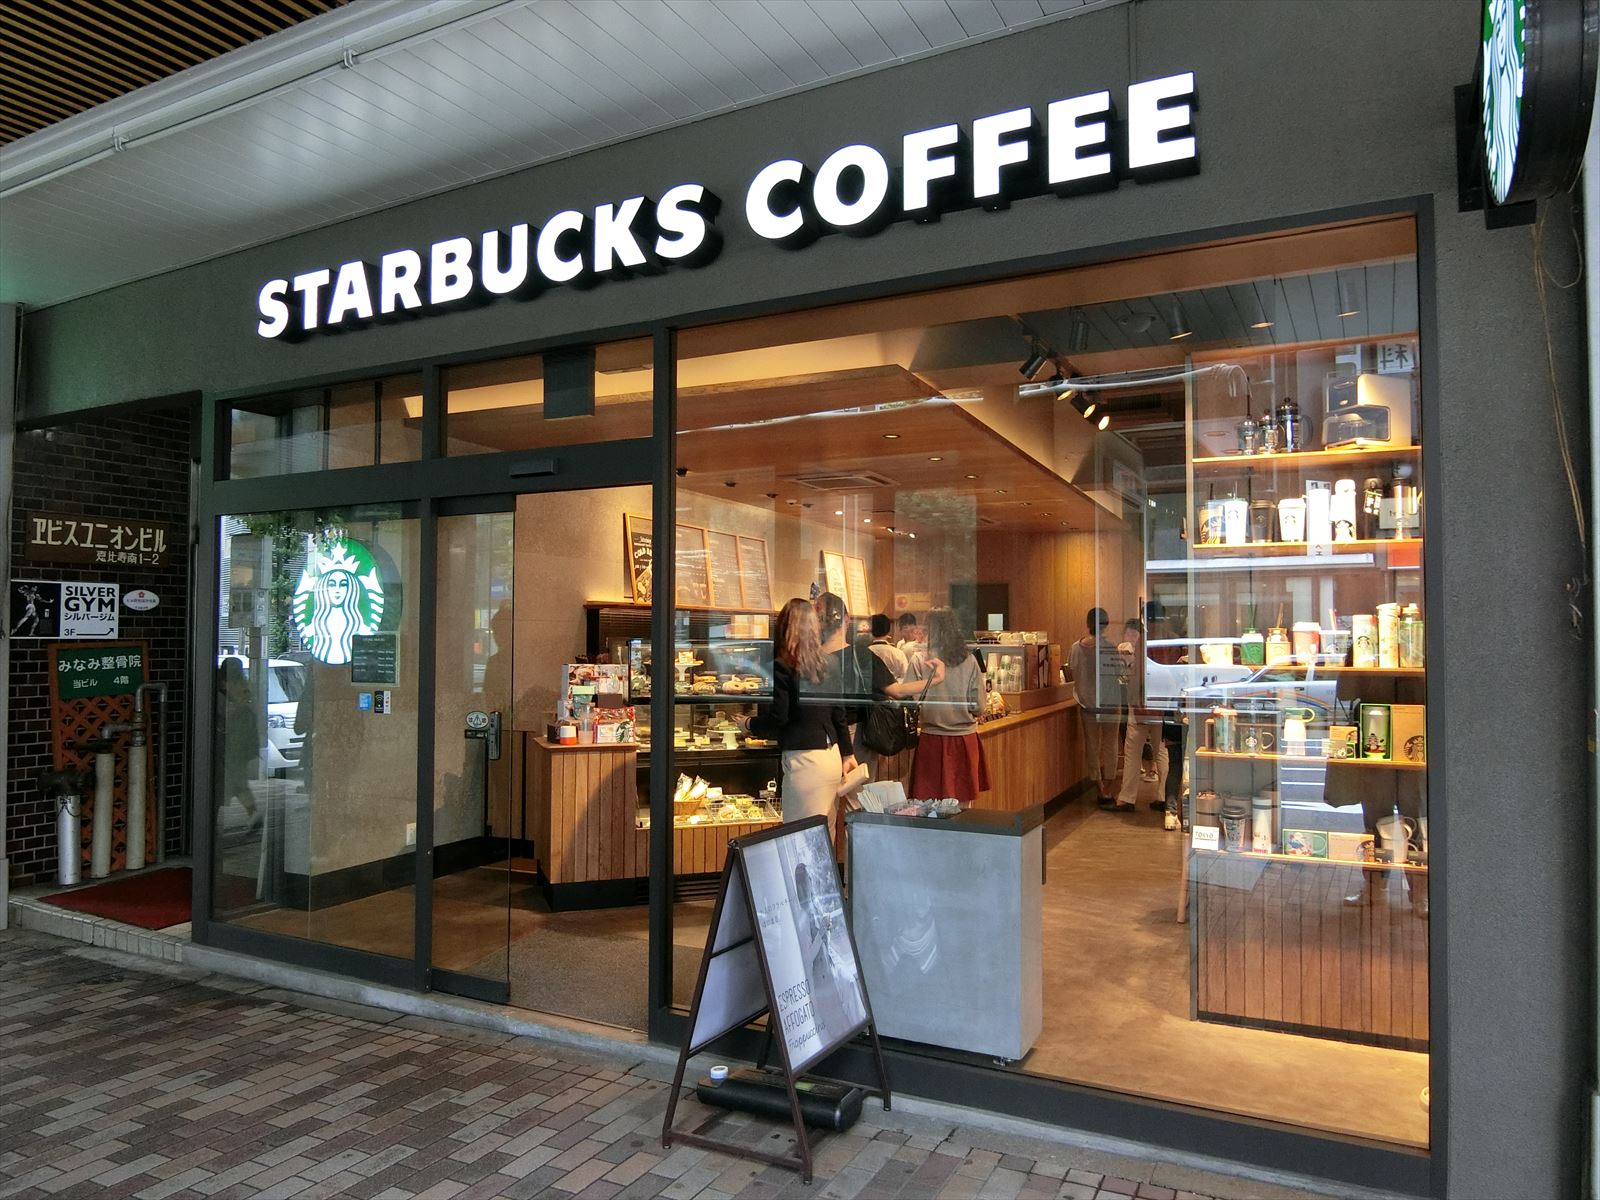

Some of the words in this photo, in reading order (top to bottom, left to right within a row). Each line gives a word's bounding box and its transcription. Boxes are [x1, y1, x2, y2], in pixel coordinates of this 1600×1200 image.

[257, 184, 705, 338] STARBUCKS
[745, 72, 1196, 239] COFFEE
[65, 585, 116, 598] SILVER
[64, 598, 116, 613] GYM
[64, 612, 116, 622] シルバージム
[64, 628, 76, 637] 3F
[58, 654, 142, 673] みなみ整骨院
[73, 678, 98, 689] 当ビル
[113, 675, 130, 685] 4階
[778, 978, 811, 1012] ESPRESSO
[783, 1000, 816, 1035] AFFOGATO
